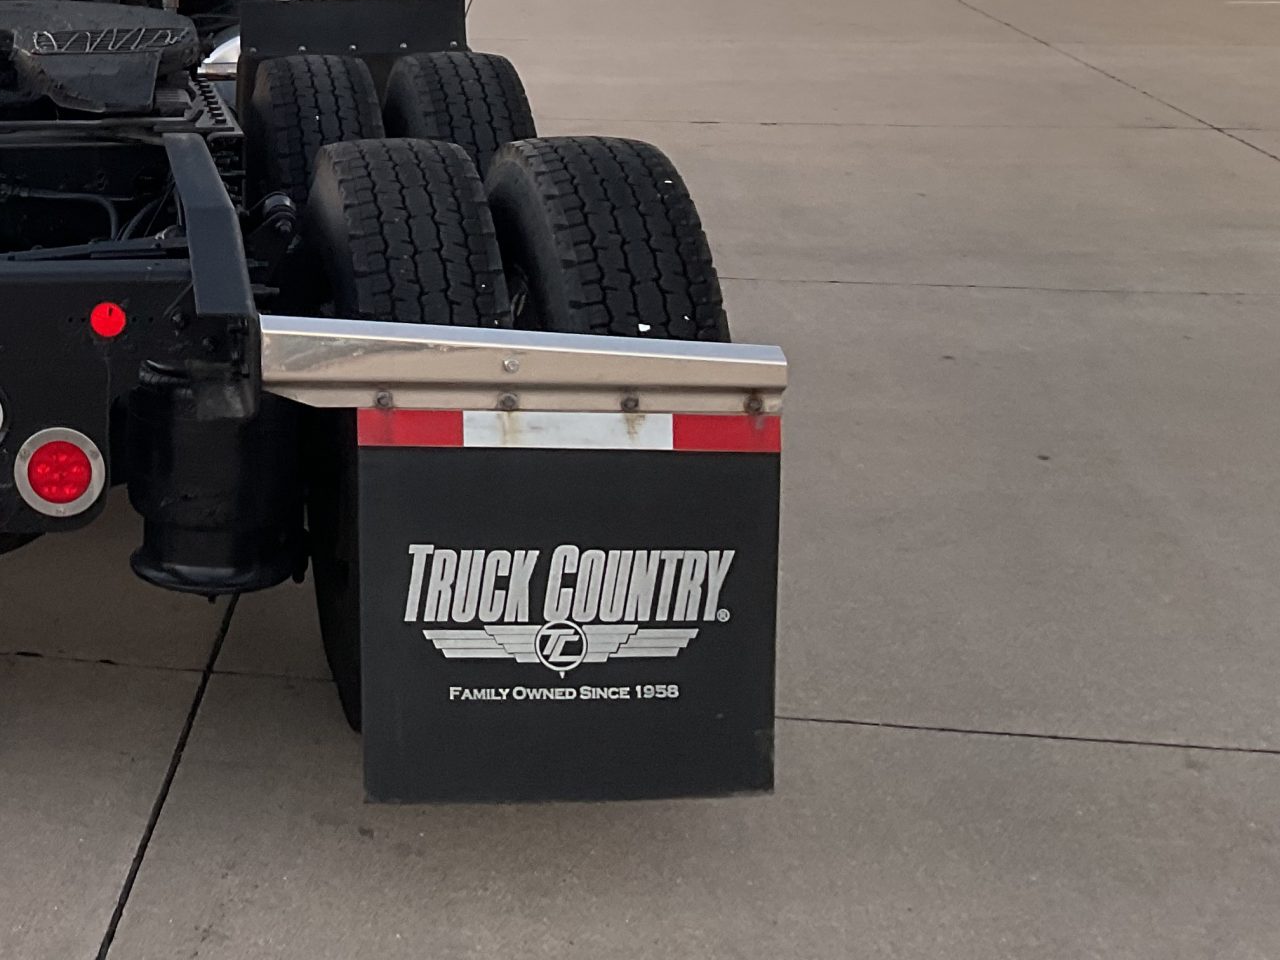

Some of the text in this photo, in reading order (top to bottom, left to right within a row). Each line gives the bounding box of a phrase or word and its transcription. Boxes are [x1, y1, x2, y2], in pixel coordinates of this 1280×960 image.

[403, 543, 540, 623] TRUCK
[449, 684, 680, 701] FAMILY OWNED SINCE 1958
